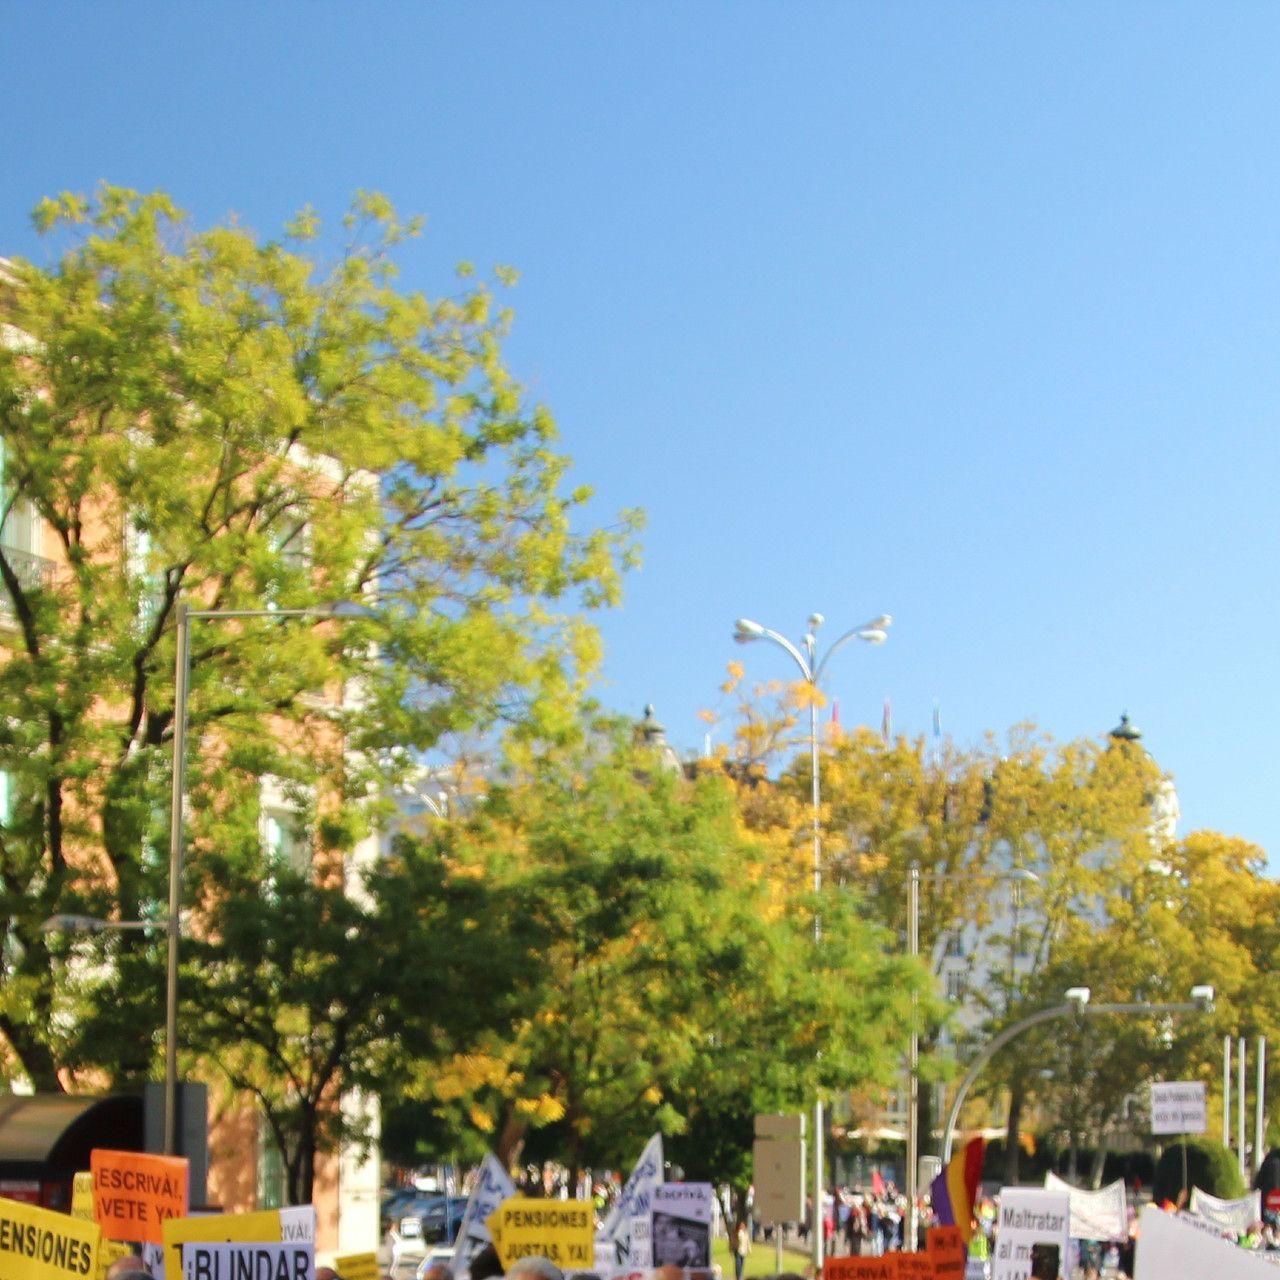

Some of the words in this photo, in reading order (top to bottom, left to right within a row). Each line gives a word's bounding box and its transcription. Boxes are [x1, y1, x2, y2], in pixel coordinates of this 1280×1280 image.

[97, 1197, 148, 1221] ¡VETE
[504, 1211, 589, 1229] PENSIONES
[1003, 1207, 1065, 1232] Maltratar
[999, 1240, 1012, 1260] al
